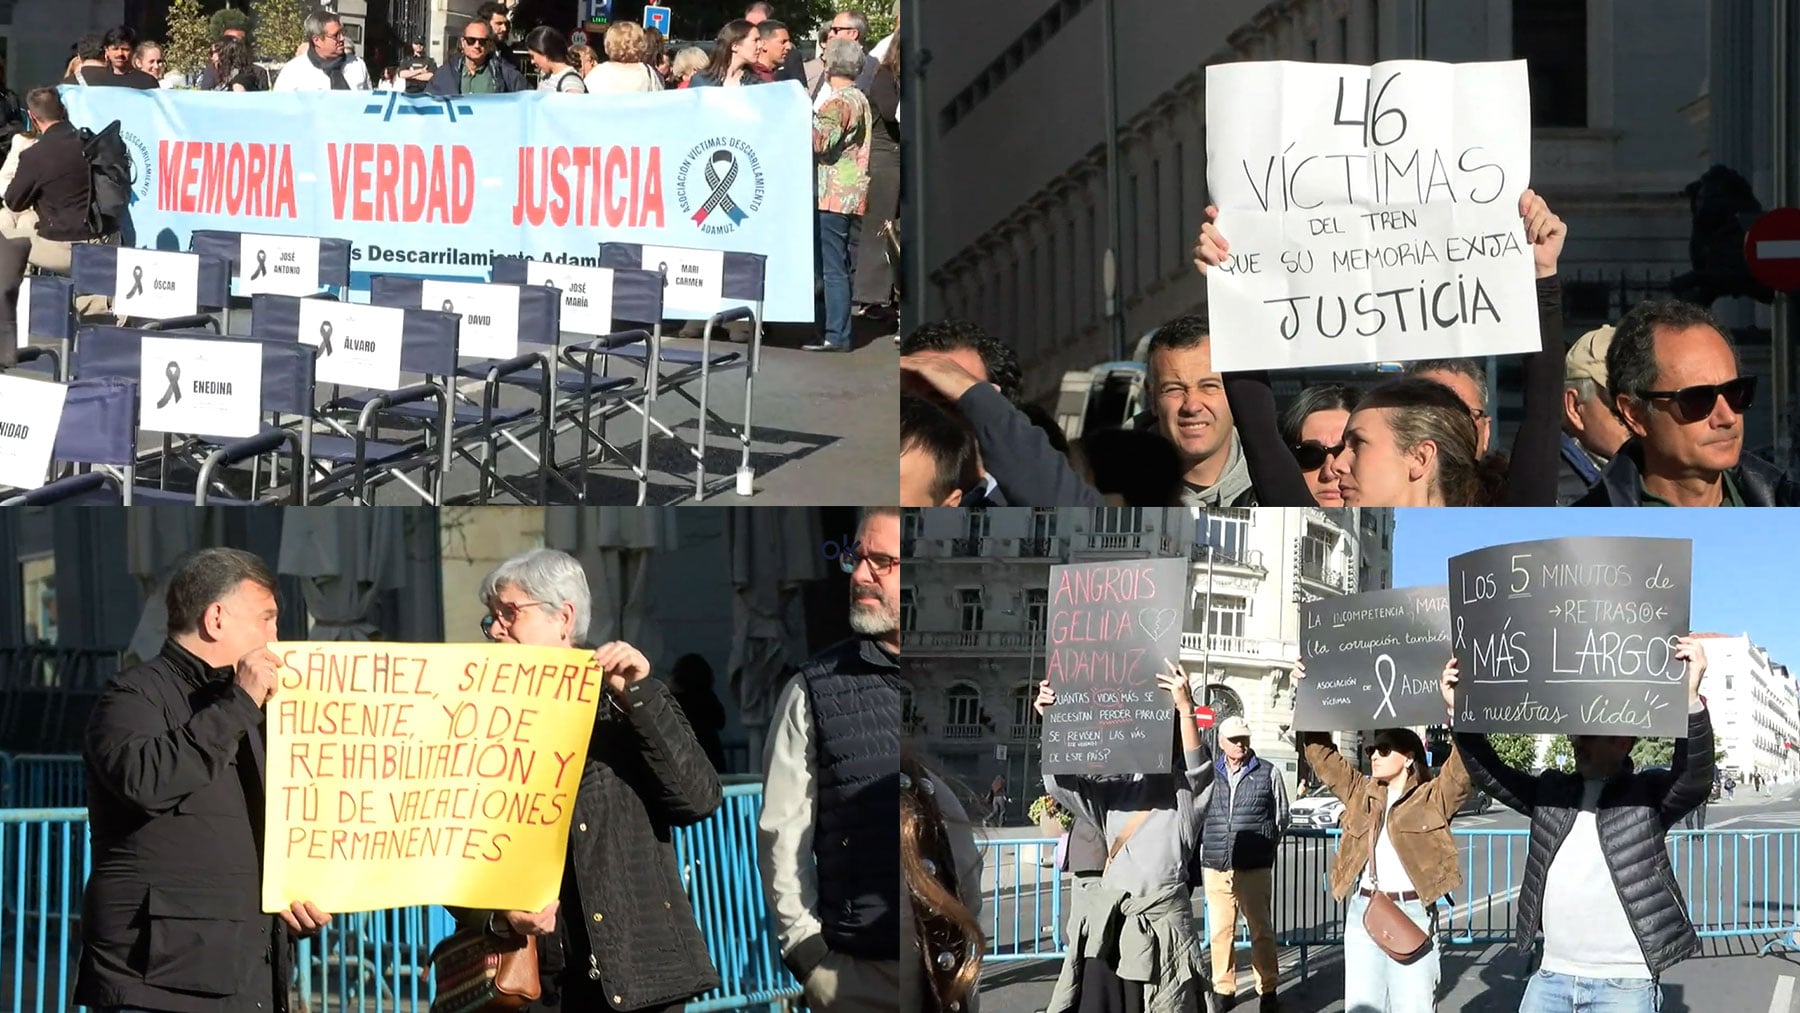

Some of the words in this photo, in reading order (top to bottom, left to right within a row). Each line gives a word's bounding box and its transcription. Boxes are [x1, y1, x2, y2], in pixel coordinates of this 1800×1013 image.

[1334, 72, 1407, 147] 46
[158, 140, 297, 219] MEMORIA
[327, 142, 475, 225] VERDAD
[512, 145, 665, 228] JUSTICIA
[1242, 141, 1505, 212] VÍCTIMAS
[701, 224, 735, 235] ADAMUZ
[1310, 217, 1345, 235] DEL
[1361, 209, 1417, 231] TREN
[274, 265, 300, 274] ANTONIO
[681, 264, 699, 274] MARI
[1218, 252, 1262, 275] QUE
[1280, 250, 1313, 273] SU
[1333, 239, 1438, 273] MEMORIA
[675, 277, 703, 287] CARMEN
[468, 314, 491, 326] DAVID
[1264, 274, 1501, 340] JUSTICIA
[344, 336, 375, 352] ÁLVARO
[193, 380, 232, 396] ENEDINA
[1054, 566, 1156, 605] ANGROIS
[1462, 571, 1497, 605] LOS
[1510, 554, 1532, 593] 5
[1542, 564, 1632, 588] MINUTOS
[1645, 563, 1675, 589] de
[1051, 609, 1134, 644] GELIDA
[1308, 611, 1322, 629] LA
[1416, 598, 1449, 615] MATA
[1339, 634, 1401, 654] corrupción
[1473, 617, 1531, 677] MÁS
[1552, 628, 1687, 682] LARGOS
[282, 647, 439, 699] SÁNCHEZ,
[458, 657, 600, 702] SIEMPRE
[1047, 648, 1148, 686] ADAMUZ
[1121, 690, 1139, 702] MÁS
[1144, 691, 1155, 702] SE
[1401, 673, 1439, 695] ADAM
[280, 700, 414, 739] AUSENTE,
[442, 700, 478, 740] YO
[486, 706, 540, 743] DE
[1050, 710, 1093, 723] NECESITAN
[1100, 709, 1131, 720] PERDER
[1461, 695, 1476, 722] de
[1482, 692, 1569, 722] nuestras
[1049, 730, 1060, 743] SE
[1109, 730, 1125, 741] LAS
[290, 738, 536, 785] REHABILITACIÓN
[554, 751, 576, 788] Y
[1049, 752, 1059, 763] DE
[1065, 752, 1082, 761] ESTE
[282, 783, 318, 821] TÚ
[339, 790, 377, 823] DE
[389, 782, 568, 825] VACACIONES
[287, 827, 512, 862] PERMANENTES
